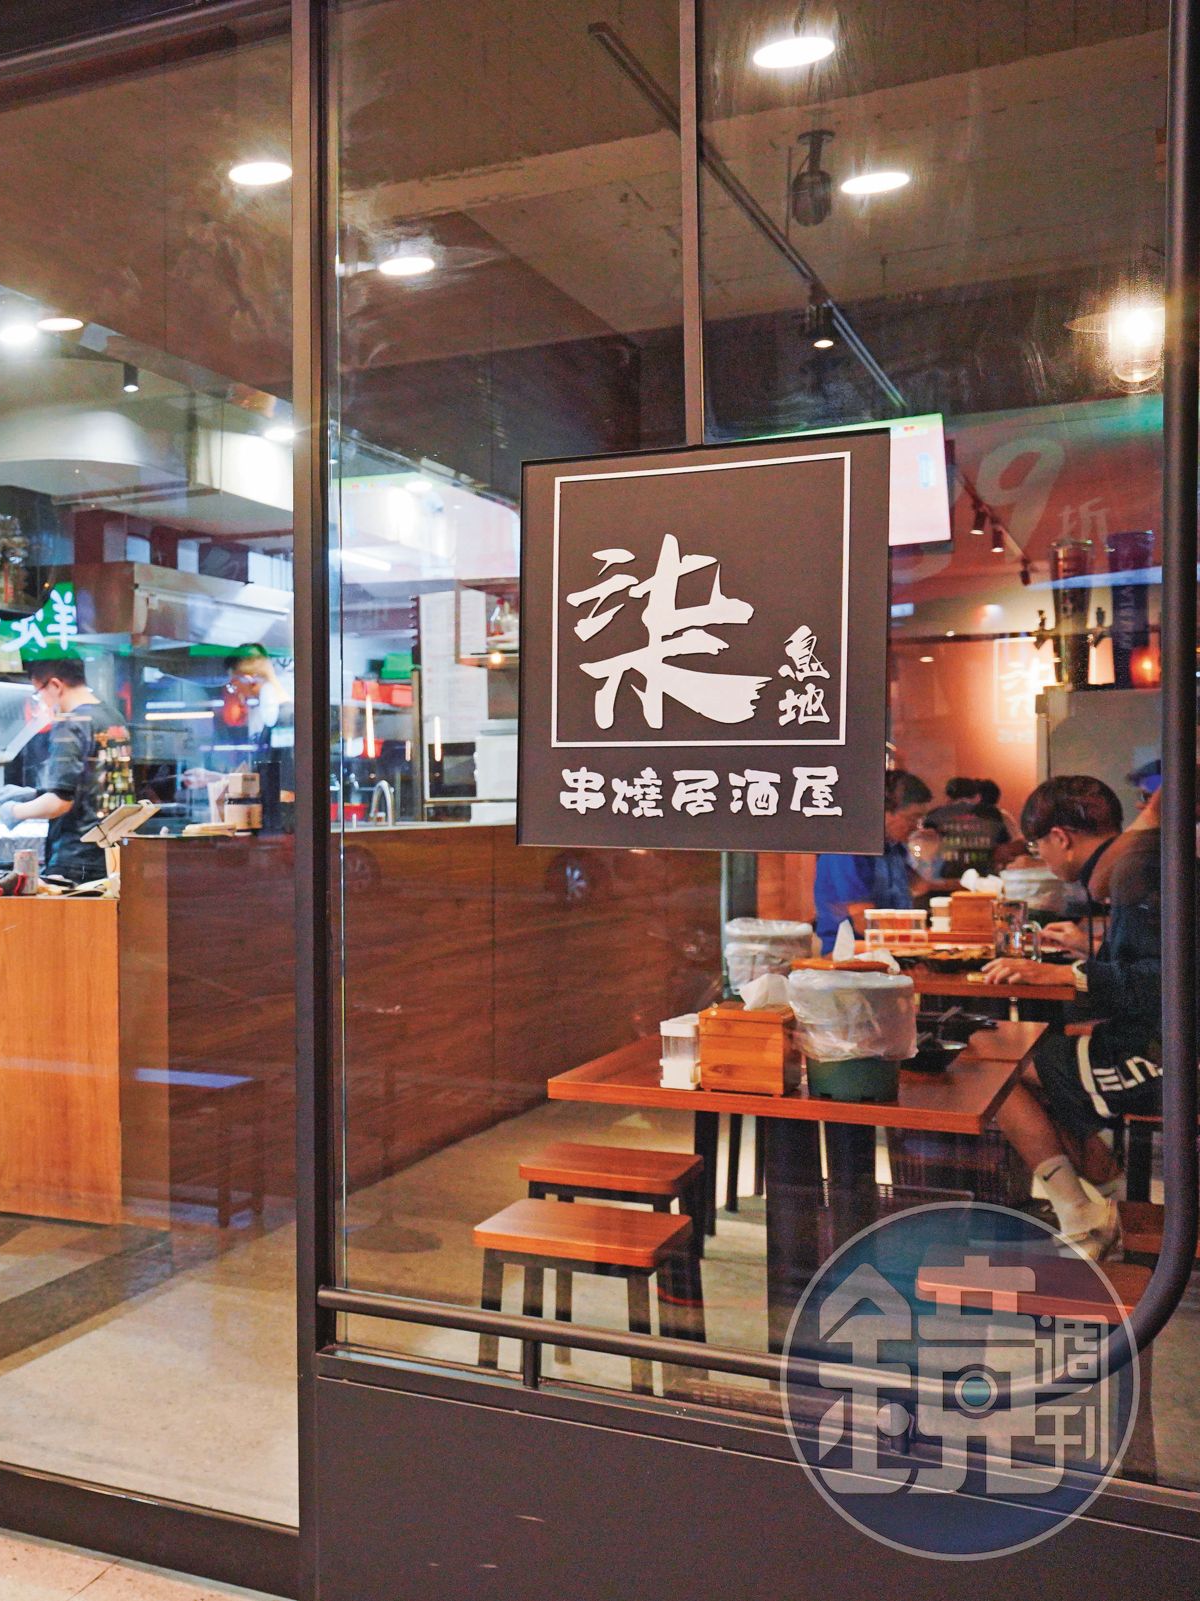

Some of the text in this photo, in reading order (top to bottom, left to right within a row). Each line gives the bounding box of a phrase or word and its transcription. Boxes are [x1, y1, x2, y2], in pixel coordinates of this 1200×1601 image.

[559, 765, 843, 819] 串燒居酒屋
